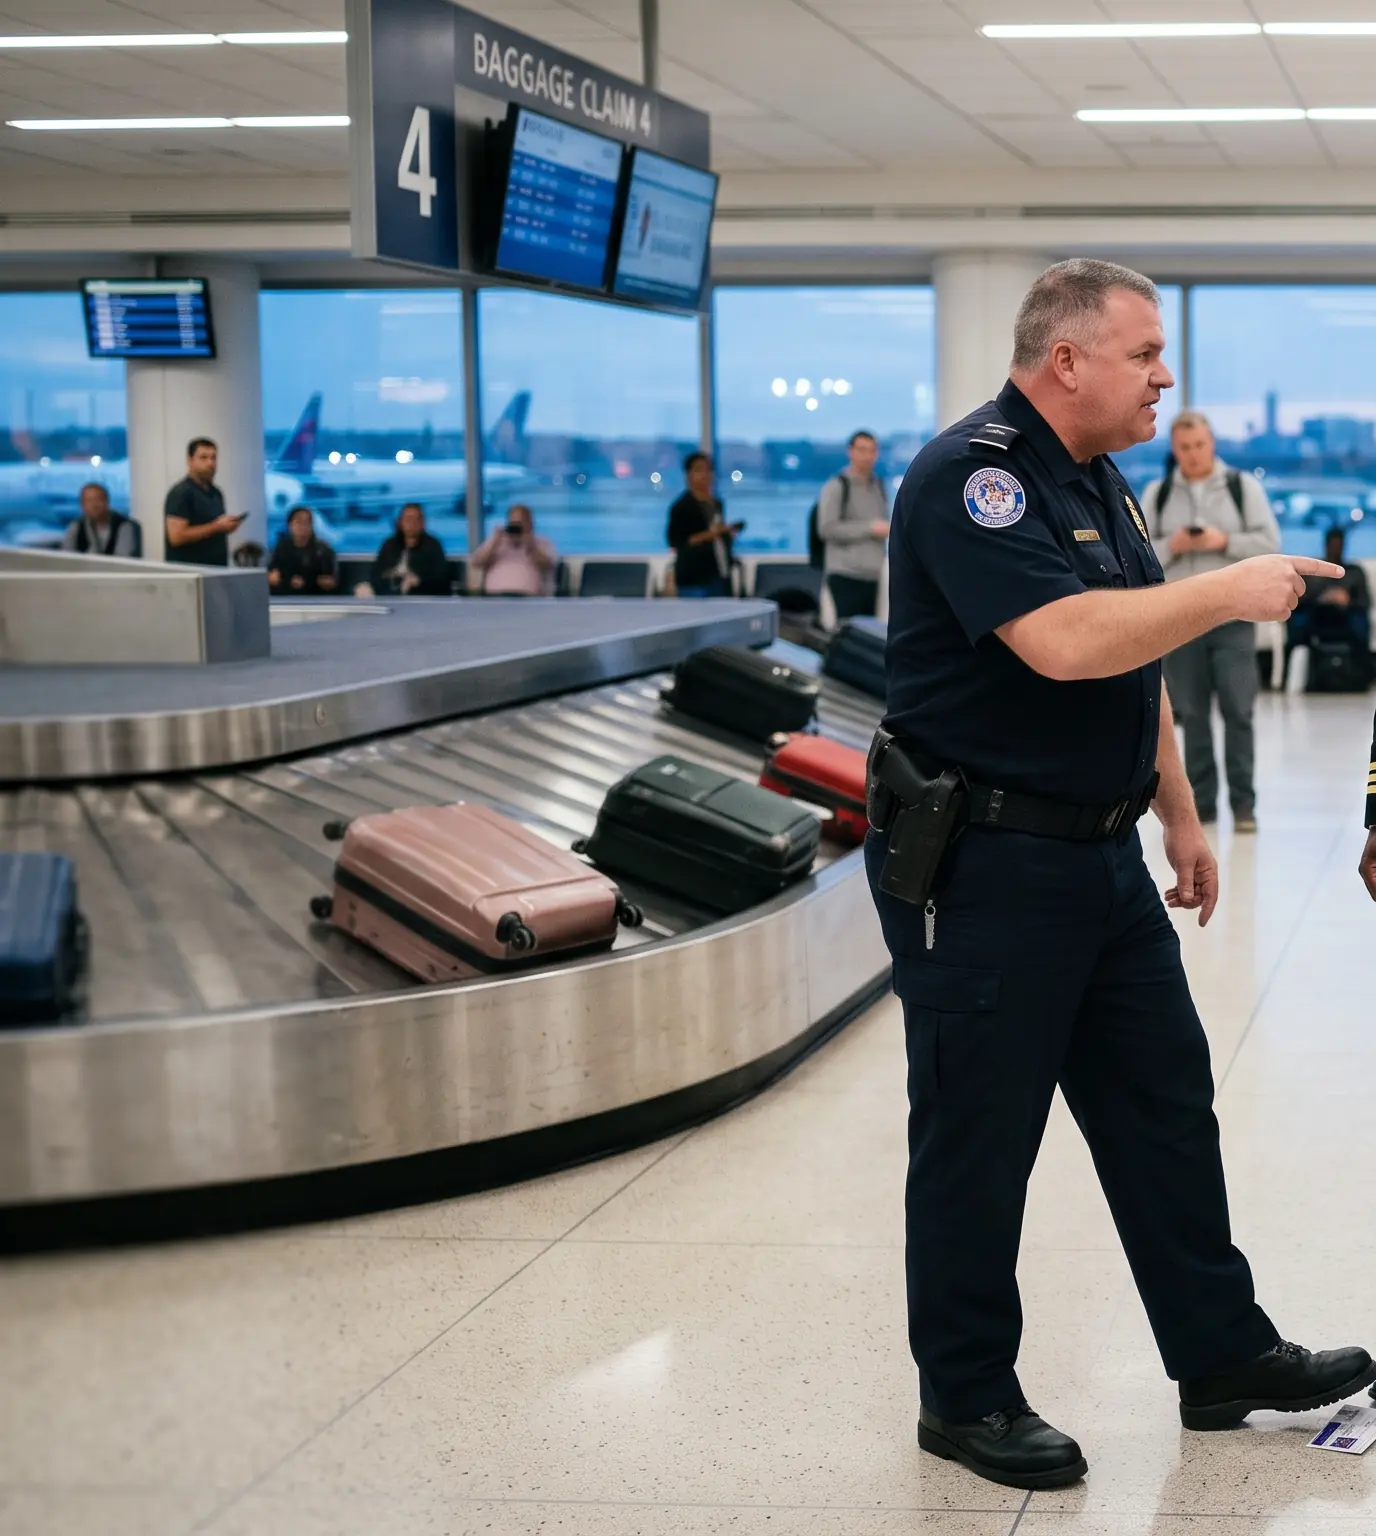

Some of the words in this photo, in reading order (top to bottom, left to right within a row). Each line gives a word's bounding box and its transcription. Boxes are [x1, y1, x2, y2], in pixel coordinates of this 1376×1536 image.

[474, 33, 574, 109] BAGGAGE
[581, 78, 636, 132] CLAIM
[640, 103, 651, 137] 4
[398, 105, 437, 217] 4
